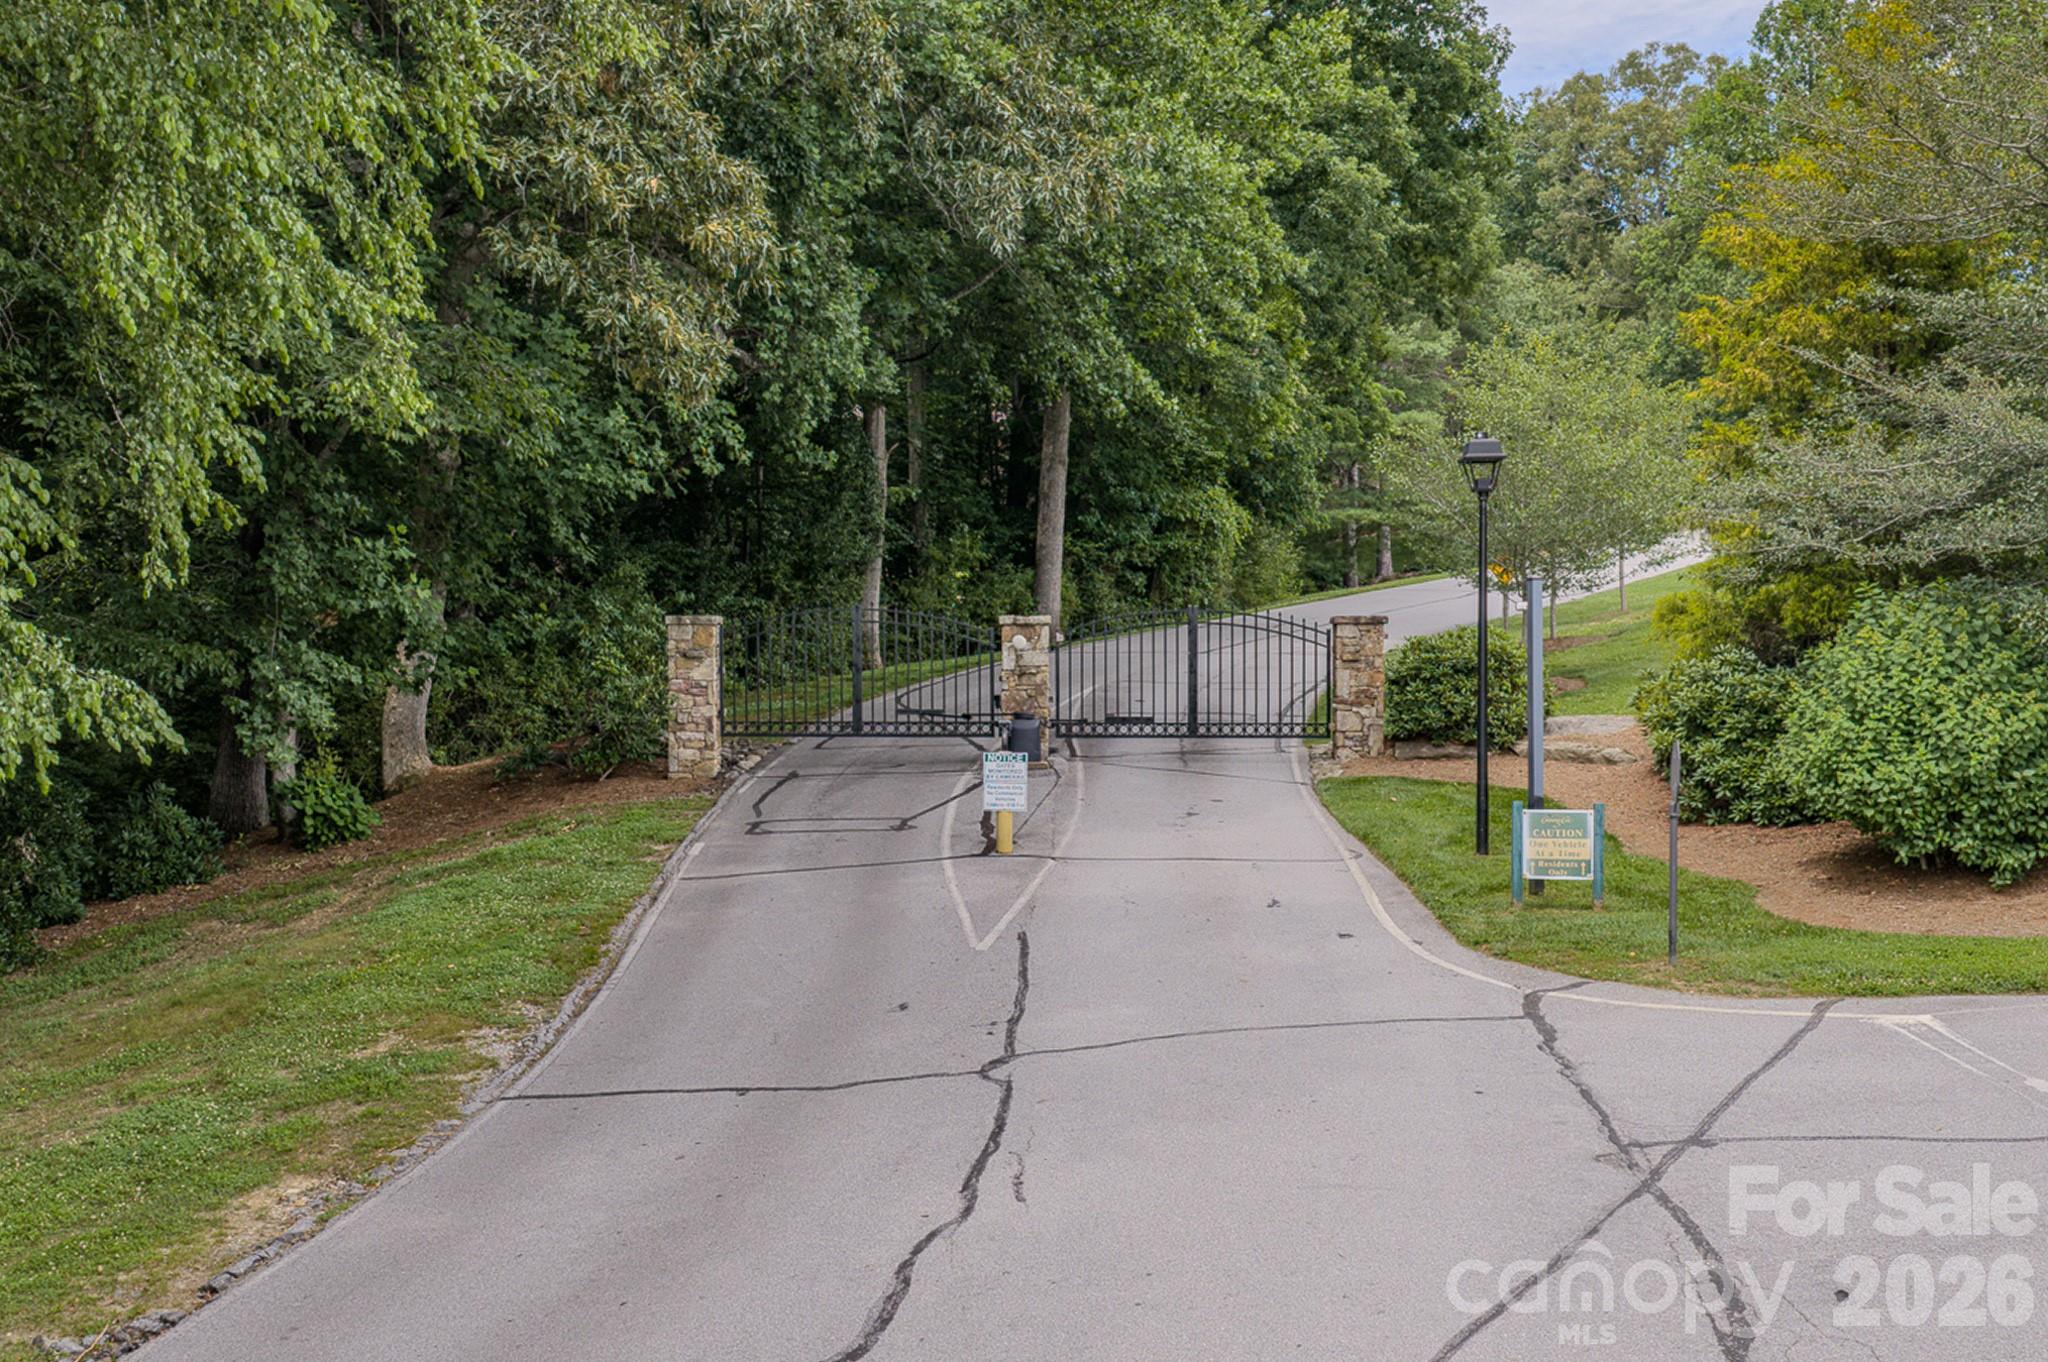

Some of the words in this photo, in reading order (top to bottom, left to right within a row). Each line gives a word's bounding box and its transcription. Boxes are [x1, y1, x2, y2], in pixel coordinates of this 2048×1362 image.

[989, 753, 1023, 763] NOTICE
[1533, 829, 1584, 837] CAUTION
[1529, 839, 1547, 848] One
[1552, 839, 1586, 848] Vehicle
[1559, 849, 1583, 857] Time
[1538, 860, 1578, 868] Residents
